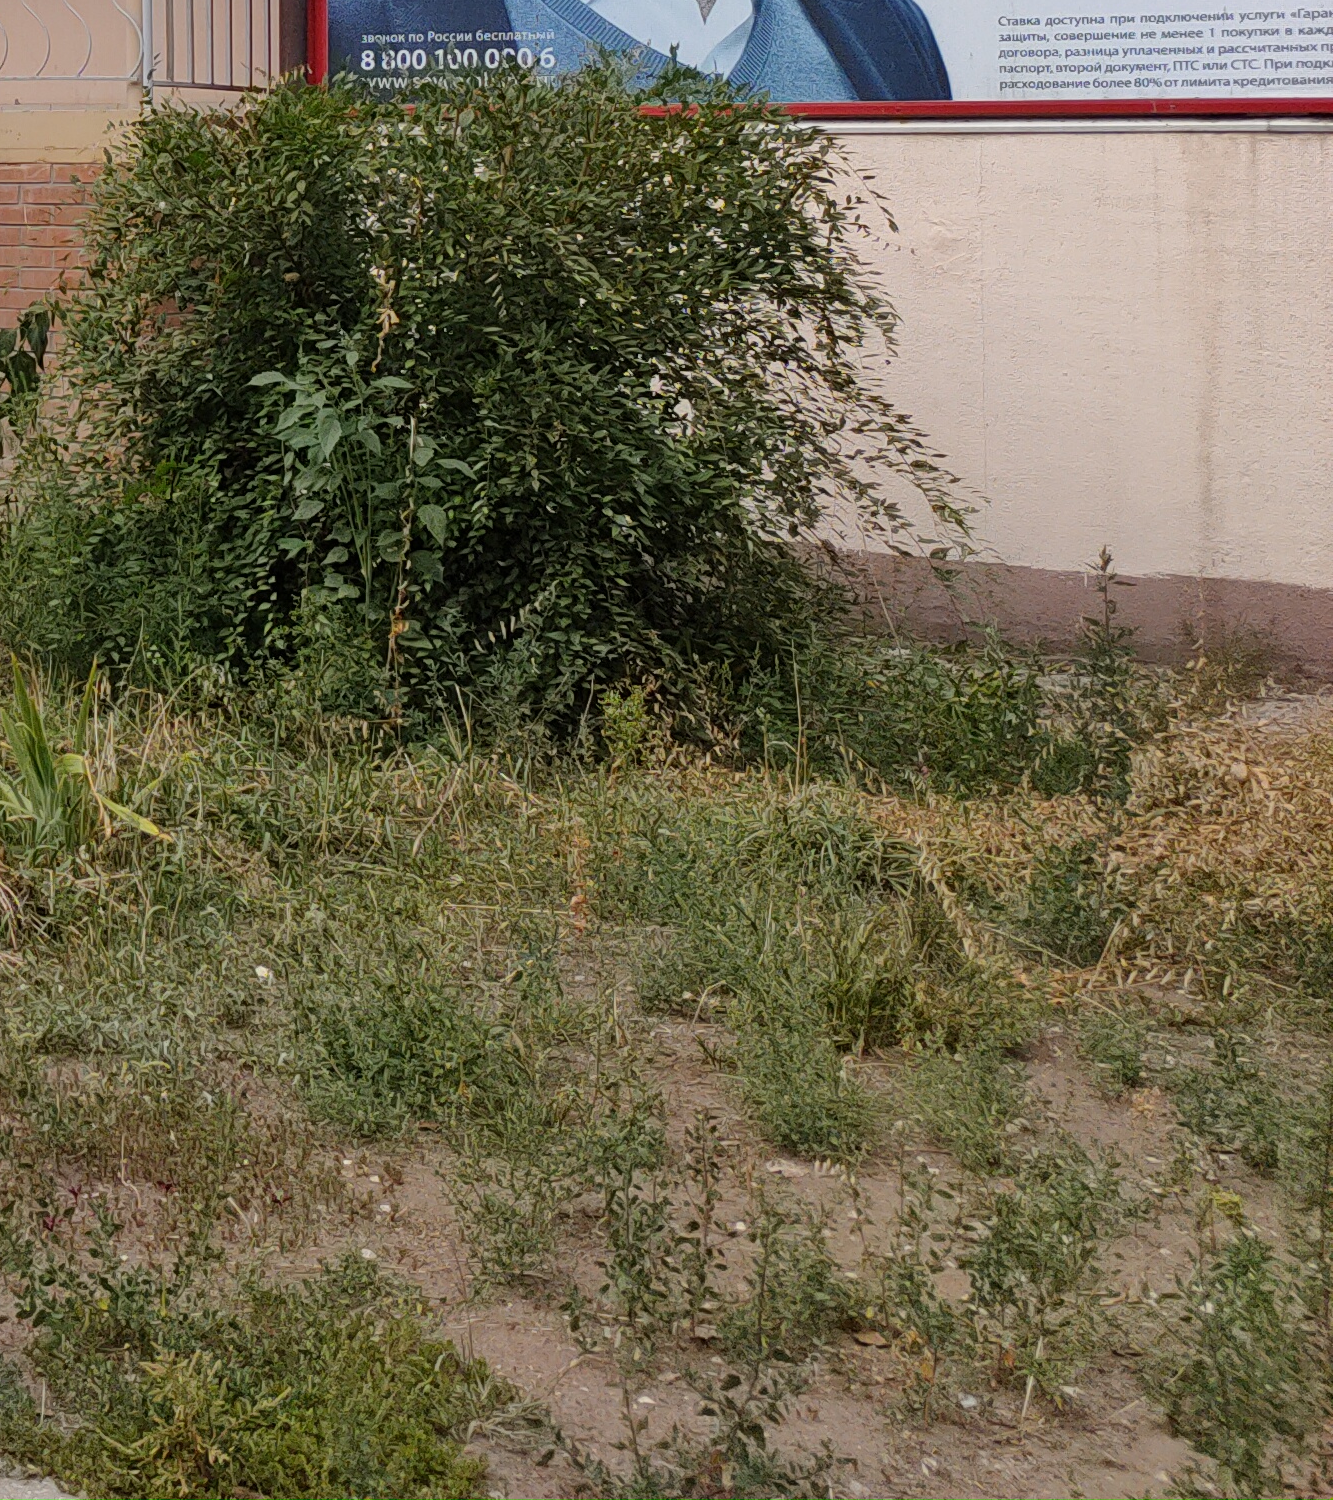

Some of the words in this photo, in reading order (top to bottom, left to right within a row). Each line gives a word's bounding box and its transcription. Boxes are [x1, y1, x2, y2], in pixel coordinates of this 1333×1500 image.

[998, 15, 1041, 26] Ставка
[1044, 16, 1105, 27] доступна
[1110, 14, 1136, 26] при
[1139, 12, 1234, 25] подключении
[1238, 11, 1286, 23] услуги
[360, 34, 406, 44] звонок
[408, 33, 425, 43] по
[427, 31, 473, 42] России
[475, 29, 555, 42] бесплатный
[998, 32, 1050, 43] защиты,
[1053, 31, 1136, 42] совершение
[1140, 30, 1157, 39] не
[1160, 29, 1204, 39] менее
[1221, 27, 1280, 40] покупки
[1284, 27, 1293, 36] в
[360, 49, 376, 71] 8
[381, 48, 427, 71] 800
[434, 48, 478, 70] 100
[998, 48, 1062, 60] договора,
[1064, 47, 1119, 60] разница
[1121, 46, 1204, 58] уплаченных
[1206, 46, 1215, 55] и
[1218, 43, 1318, 56] рассчитанных
[999, 64, 1053, 76] паспорт,
[1055, 62, 1102, 74] второй
[1104, 63, 1171, 75] документ,
[1173, 60, 1200, 72] ПТС
[1202, 61, 1228, 71] или
[1264, 58, 1293, 72] При
[999, 80, 1091, 91] расходование
[1092, 77, 1132, 89] более
[1134, 77, 1163, 89] 80%
[1163, 79, 1179, 88] от
[1180, 78, 1231, 88] лимита
[1232, 76, 1333, 89] кредитования
